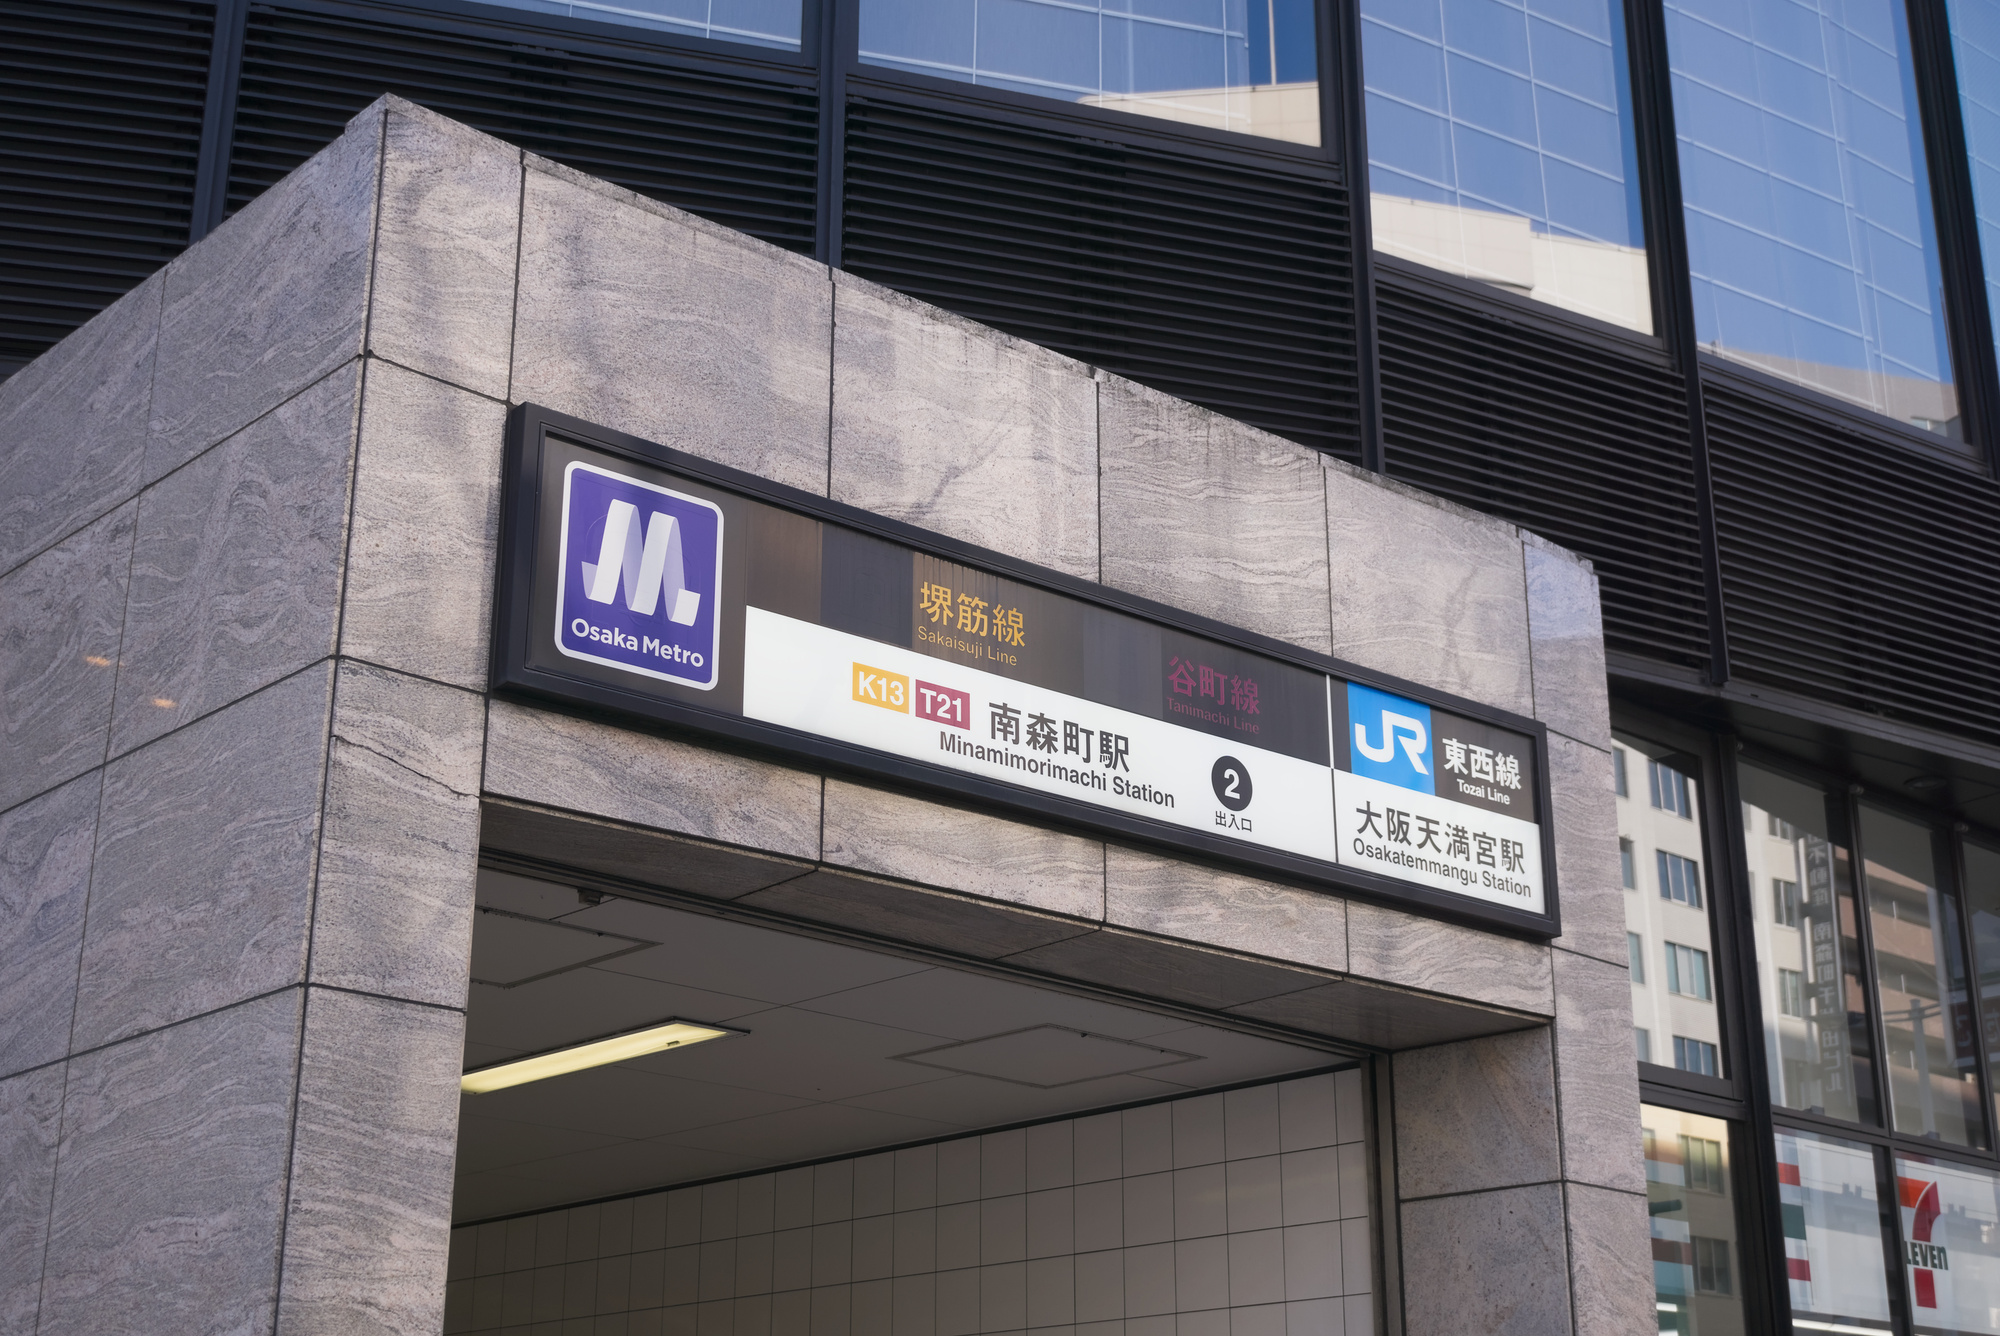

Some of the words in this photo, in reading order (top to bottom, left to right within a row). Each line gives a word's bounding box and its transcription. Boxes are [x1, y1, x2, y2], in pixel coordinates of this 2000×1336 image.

[919, 581, 1026, 647] 堺筋線
[571, 618, 638, 651] Osaka
[643, 635, 704, 667] Metro
[917, 625, 983, 659] Sakaisuji
[988, 645, 1018, 666] Line
[858, 671, 905, 706] K13
[920, 688, 962, 722] T21
[1168, 655, 1260, 715] 谷町線
[988, 702, 1130, 773] 南森町駅
[1167, 697, 1230, 727] Tanimachi
[1234, 716, 1260, 735] Line
[1354, 709, 1429, 775] JR
[1442, 738, 1522, 790] 東西線
[940, 731, 1107, 791] Minamimorimachi
[1113, 775, 1175, 808] Station
[1223, 768, 1241, 800] 2
[1456, 778, 1485, 799] Tozai
[1488, 788, 1511, 805] Line
[1215, 810, 1253, 832] 出入口
[1355, 800, 1525, 874] 大阪天満宮駅
[1353, 837, 1478, 886] Osakatemmangu
[1482, 871, 1532, 898] Station
